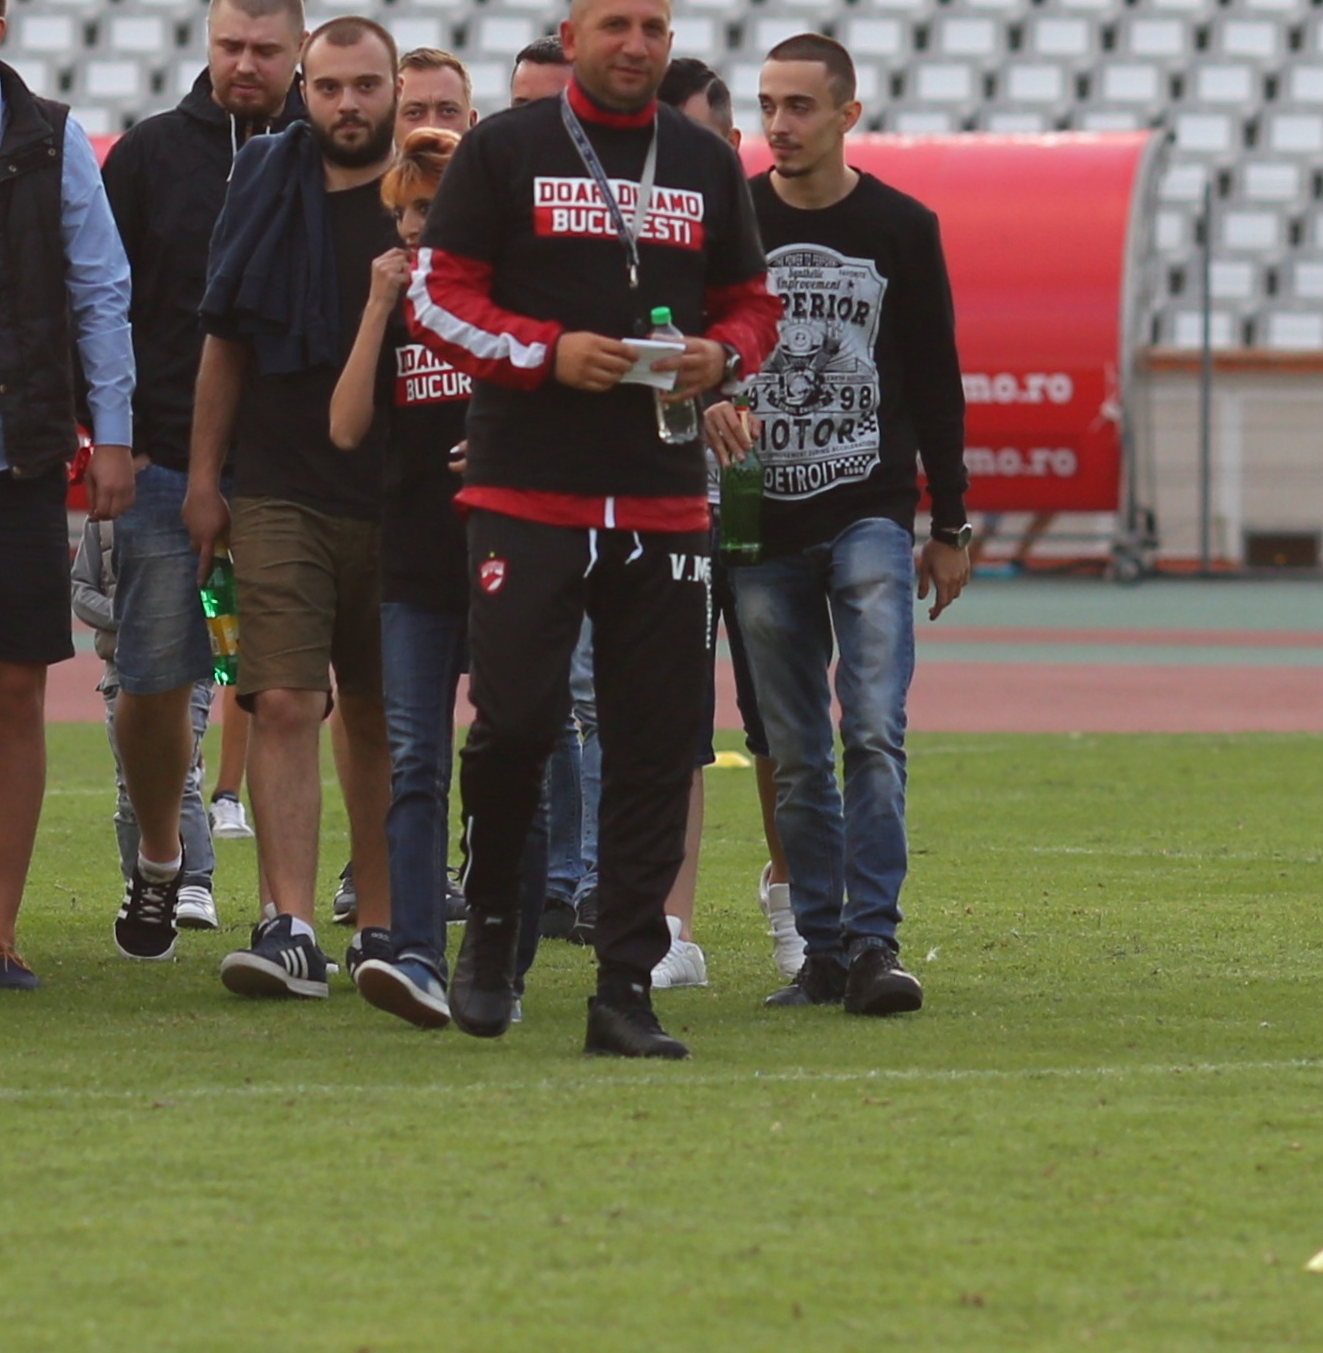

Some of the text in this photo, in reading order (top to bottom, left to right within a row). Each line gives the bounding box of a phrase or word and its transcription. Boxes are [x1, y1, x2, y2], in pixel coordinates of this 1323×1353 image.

[618, 184, 700, 217] DIAMO
[777, 292, 870, 327] PERIOR
[406, 372, 473, 402] BUCUR
[840, 386, 872, 410] 98
[961, 372, 1073, 404] mo.ro
[764, 462, 837, 492] DETROIT
[962, 448, 1077, 477] mo.ro
